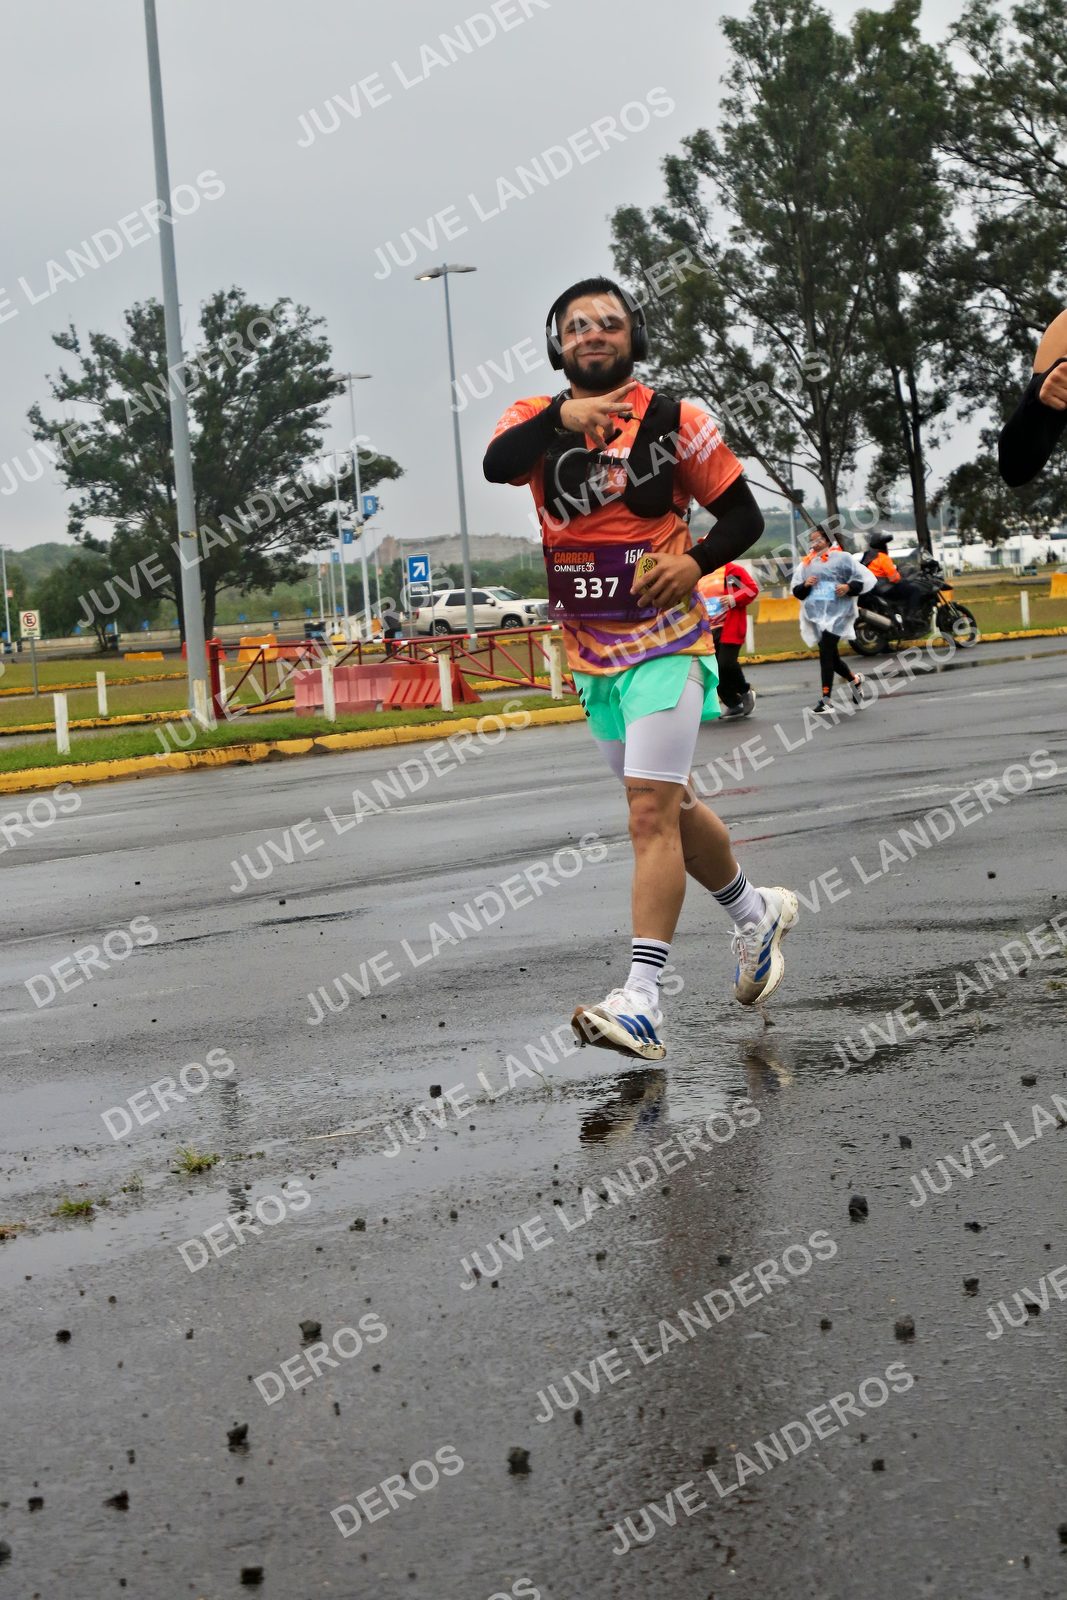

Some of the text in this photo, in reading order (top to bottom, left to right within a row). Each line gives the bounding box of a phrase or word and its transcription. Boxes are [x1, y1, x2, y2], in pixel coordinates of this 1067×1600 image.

[366, 500, 374, 511] 8
[554, 552, 595, 564] CARRERA
[553, 564, 586, 572] OMNILIFE
[573, 577, 619, 599] 337
